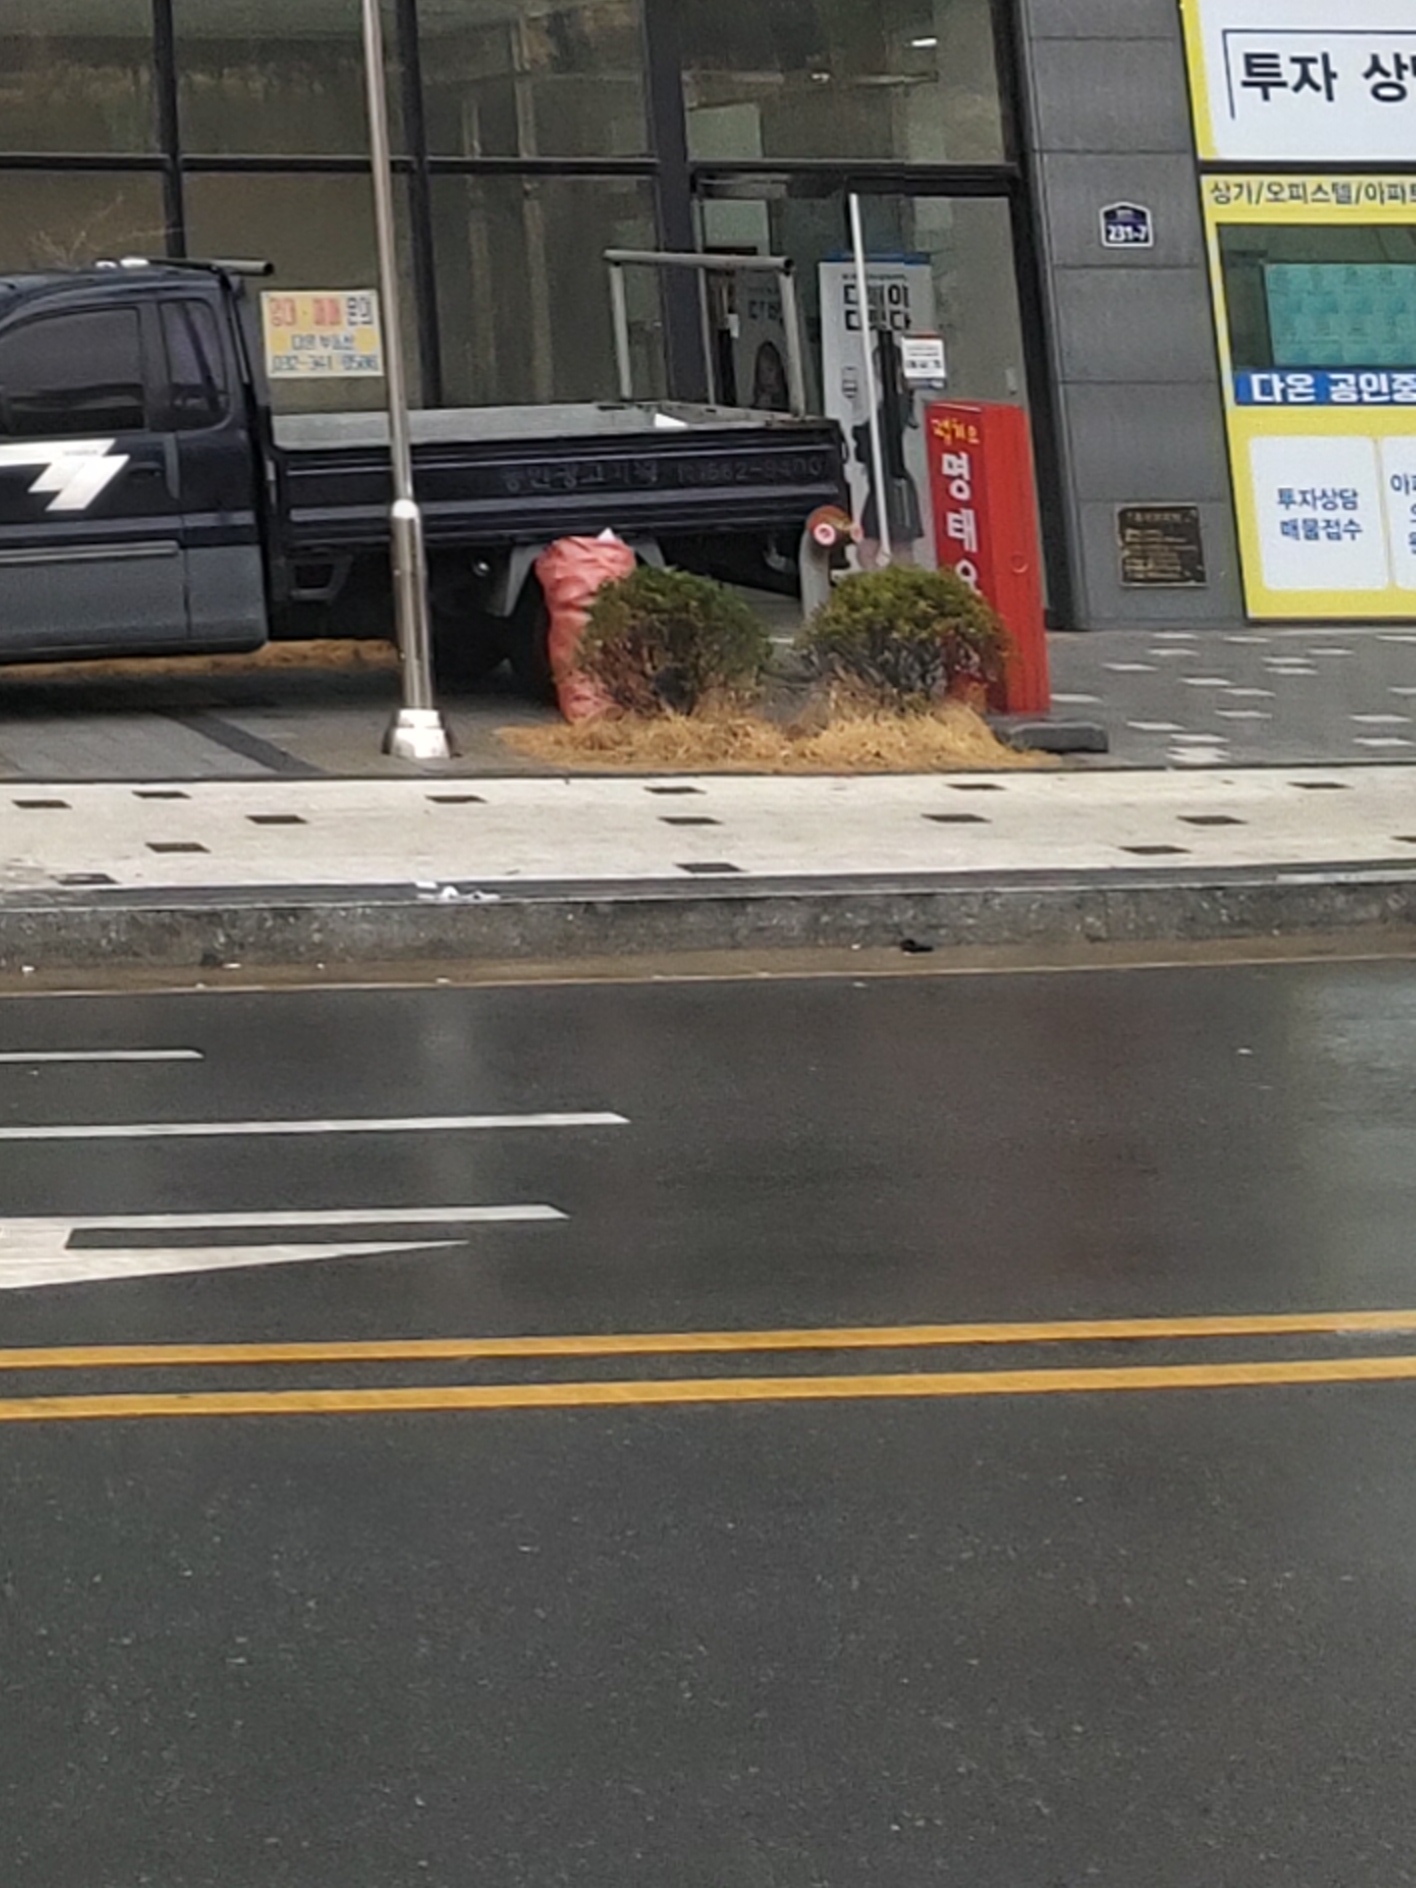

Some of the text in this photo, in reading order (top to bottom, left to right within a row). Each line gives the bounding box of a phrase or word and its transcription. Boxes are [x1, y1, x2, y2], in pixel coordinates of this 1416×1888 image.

[1241, 51, 1416, 103] 투자 상
[1250, 372, 1316, 403] 다온
[1277, 487, 1359, 512] 투자상담
[1279, 518, 1364, 542] 매물접수
